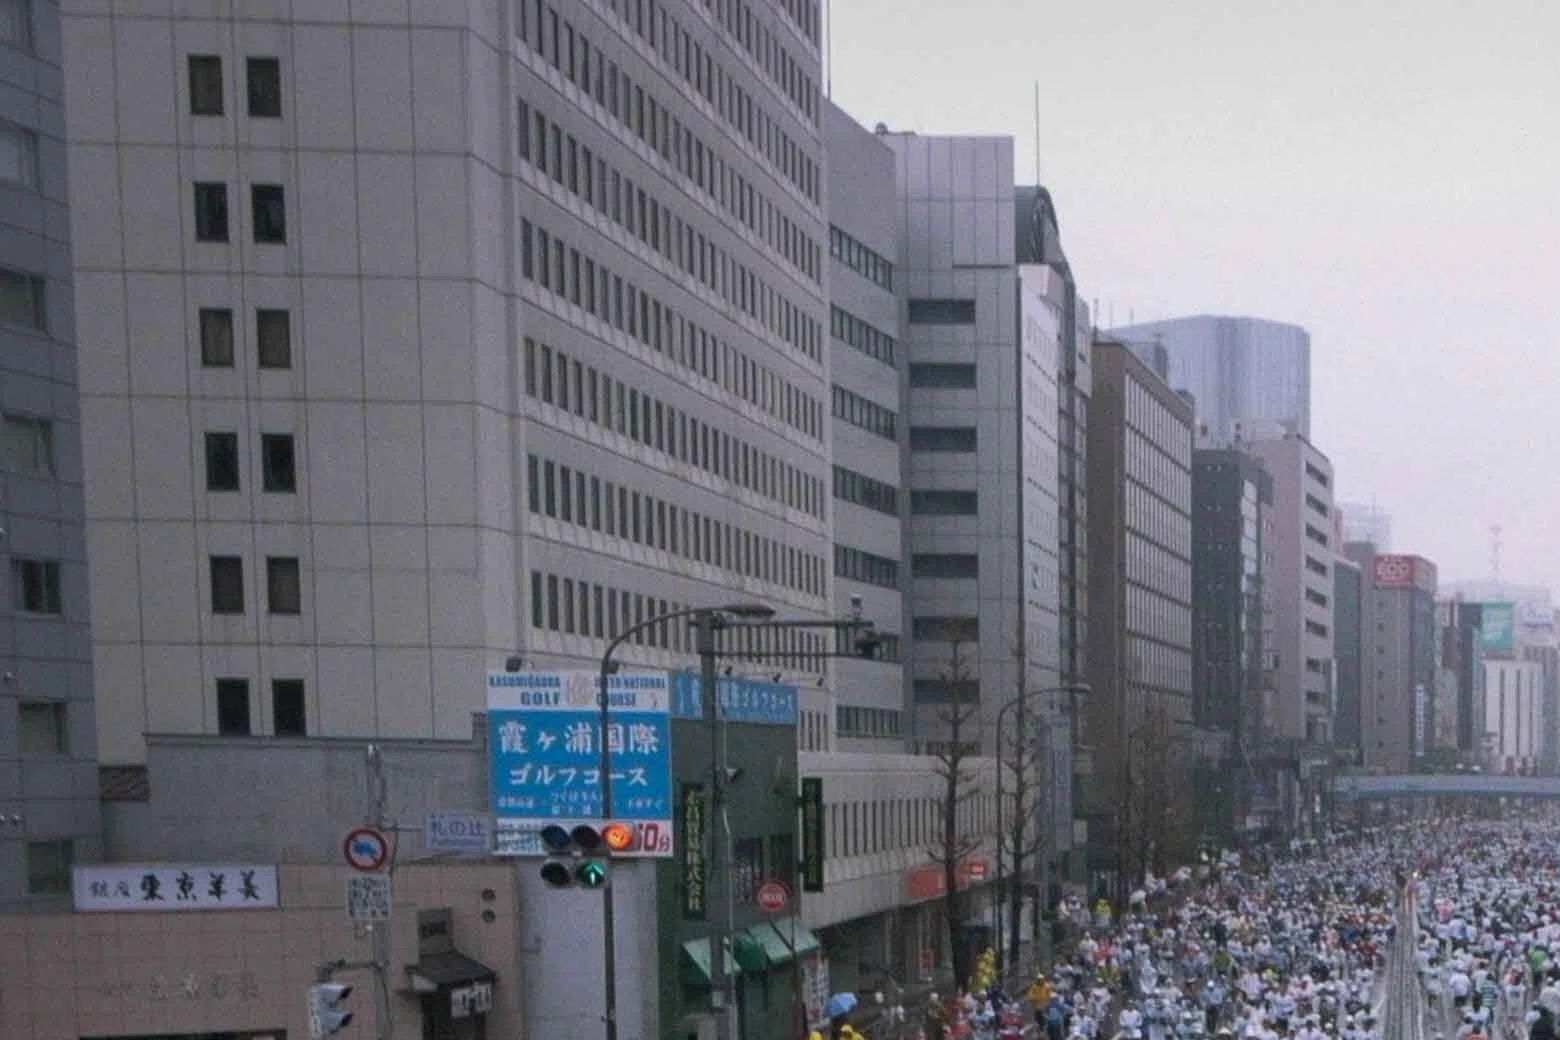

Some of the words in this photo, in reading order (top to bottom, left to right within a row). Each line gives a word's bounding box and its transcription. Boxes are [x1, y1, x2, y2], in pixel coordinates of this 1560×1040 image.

[594, 674, 665, 688] INERNATIONAL
[520, 691, 561, 705] GOLF
[595, 692, 636, 706] CURSE
[498, 720, 659, 756] 霞ヶ浦国際
[509, 761, 648, 787] ゴルフコース
[430, 814, 482, 837] 札の辻
